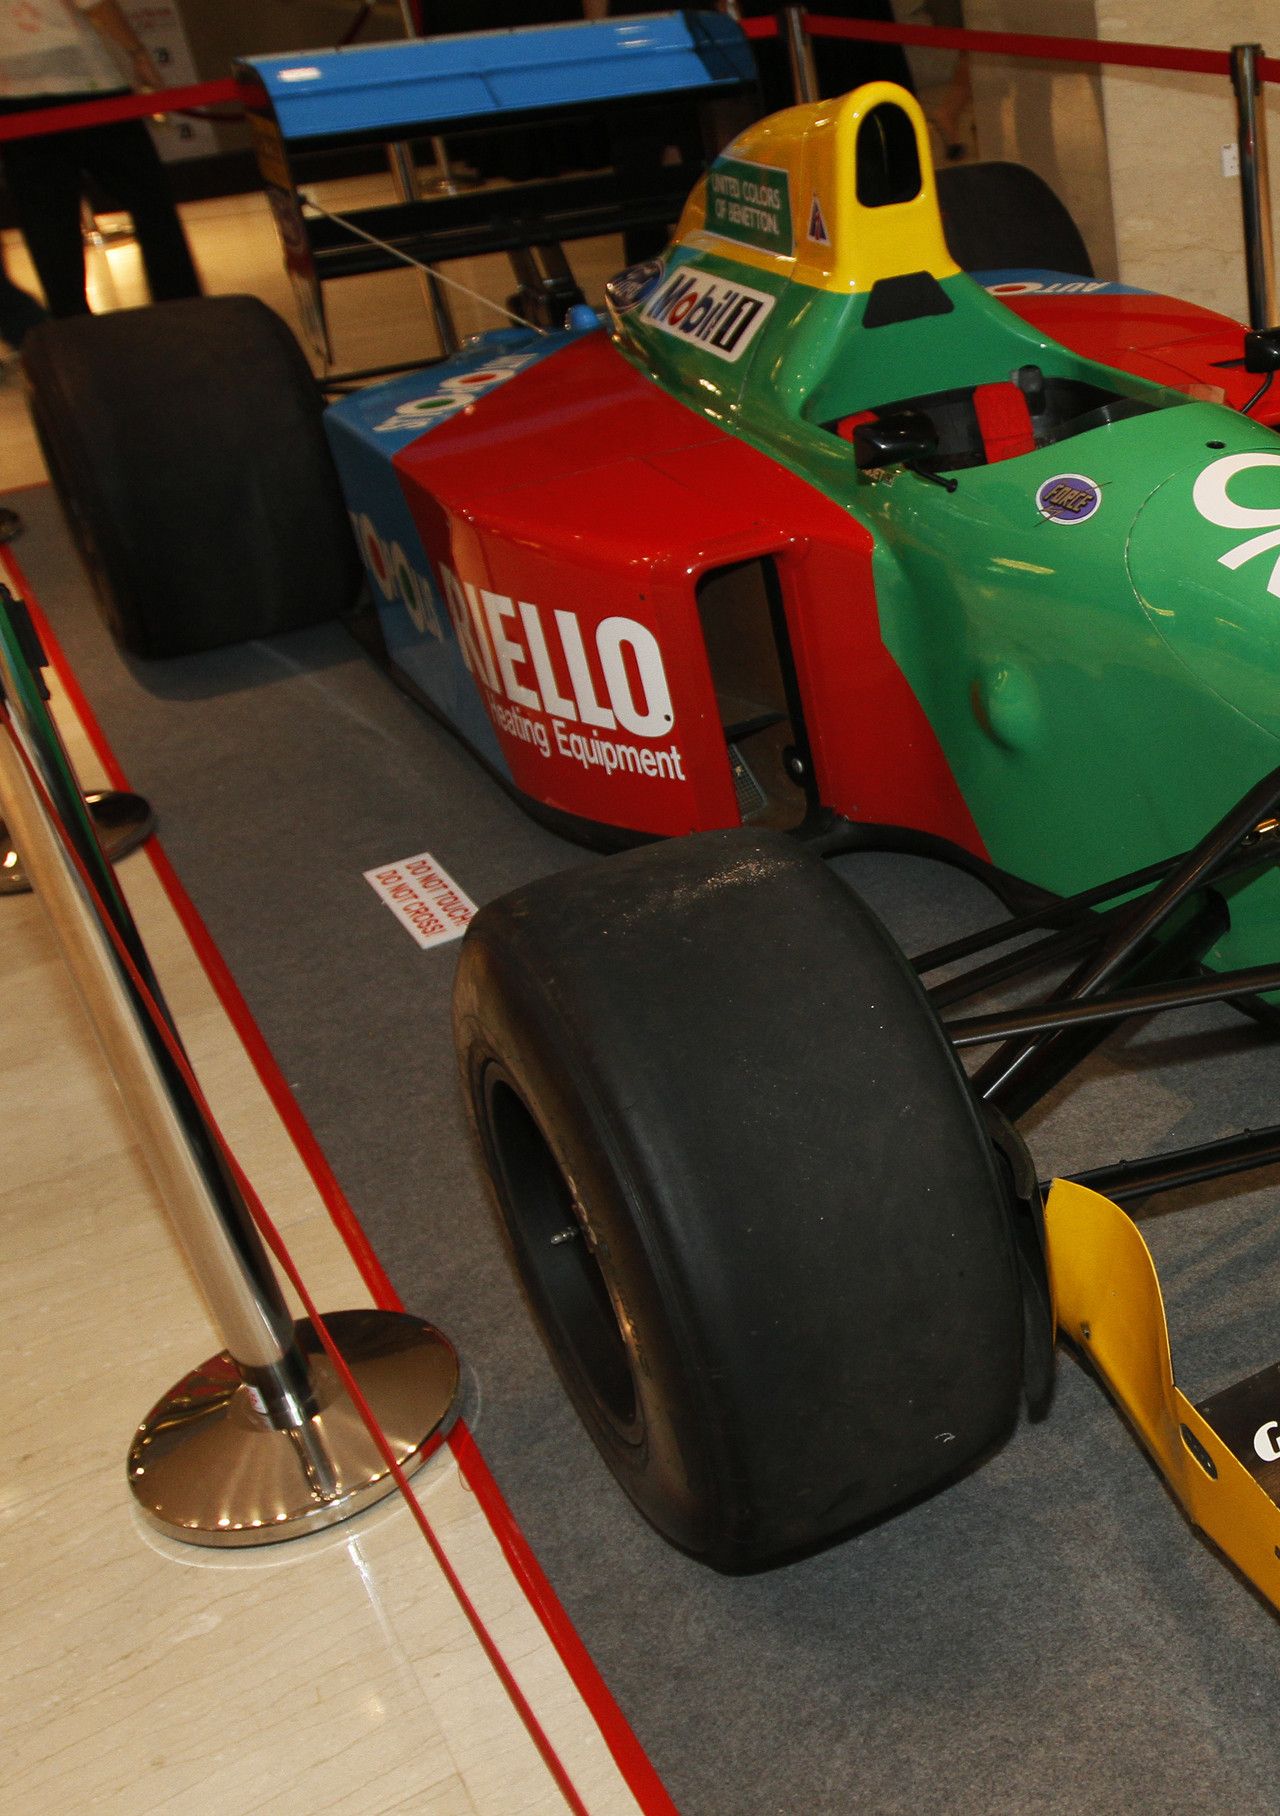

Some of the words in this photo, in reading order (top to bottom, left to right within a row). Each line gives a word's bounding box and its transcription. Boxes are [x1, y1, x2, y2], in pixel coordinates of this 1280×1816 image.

[742, 181, 781, 209] COLORS
[715, 198, 725, 218] OF
[1043, 483, 1096, 513] FORCE
[438, 562, 674, 738] RIELLO
[552, 719, 686, 781] Equipment
[376, 869, 402, 886] DO
[405, 859, 432, 876] DO
[387, 882, 418, 903] NOT
[416, 873, 448, 893] NOT
[403, 901, 446, 938] CROSS!
